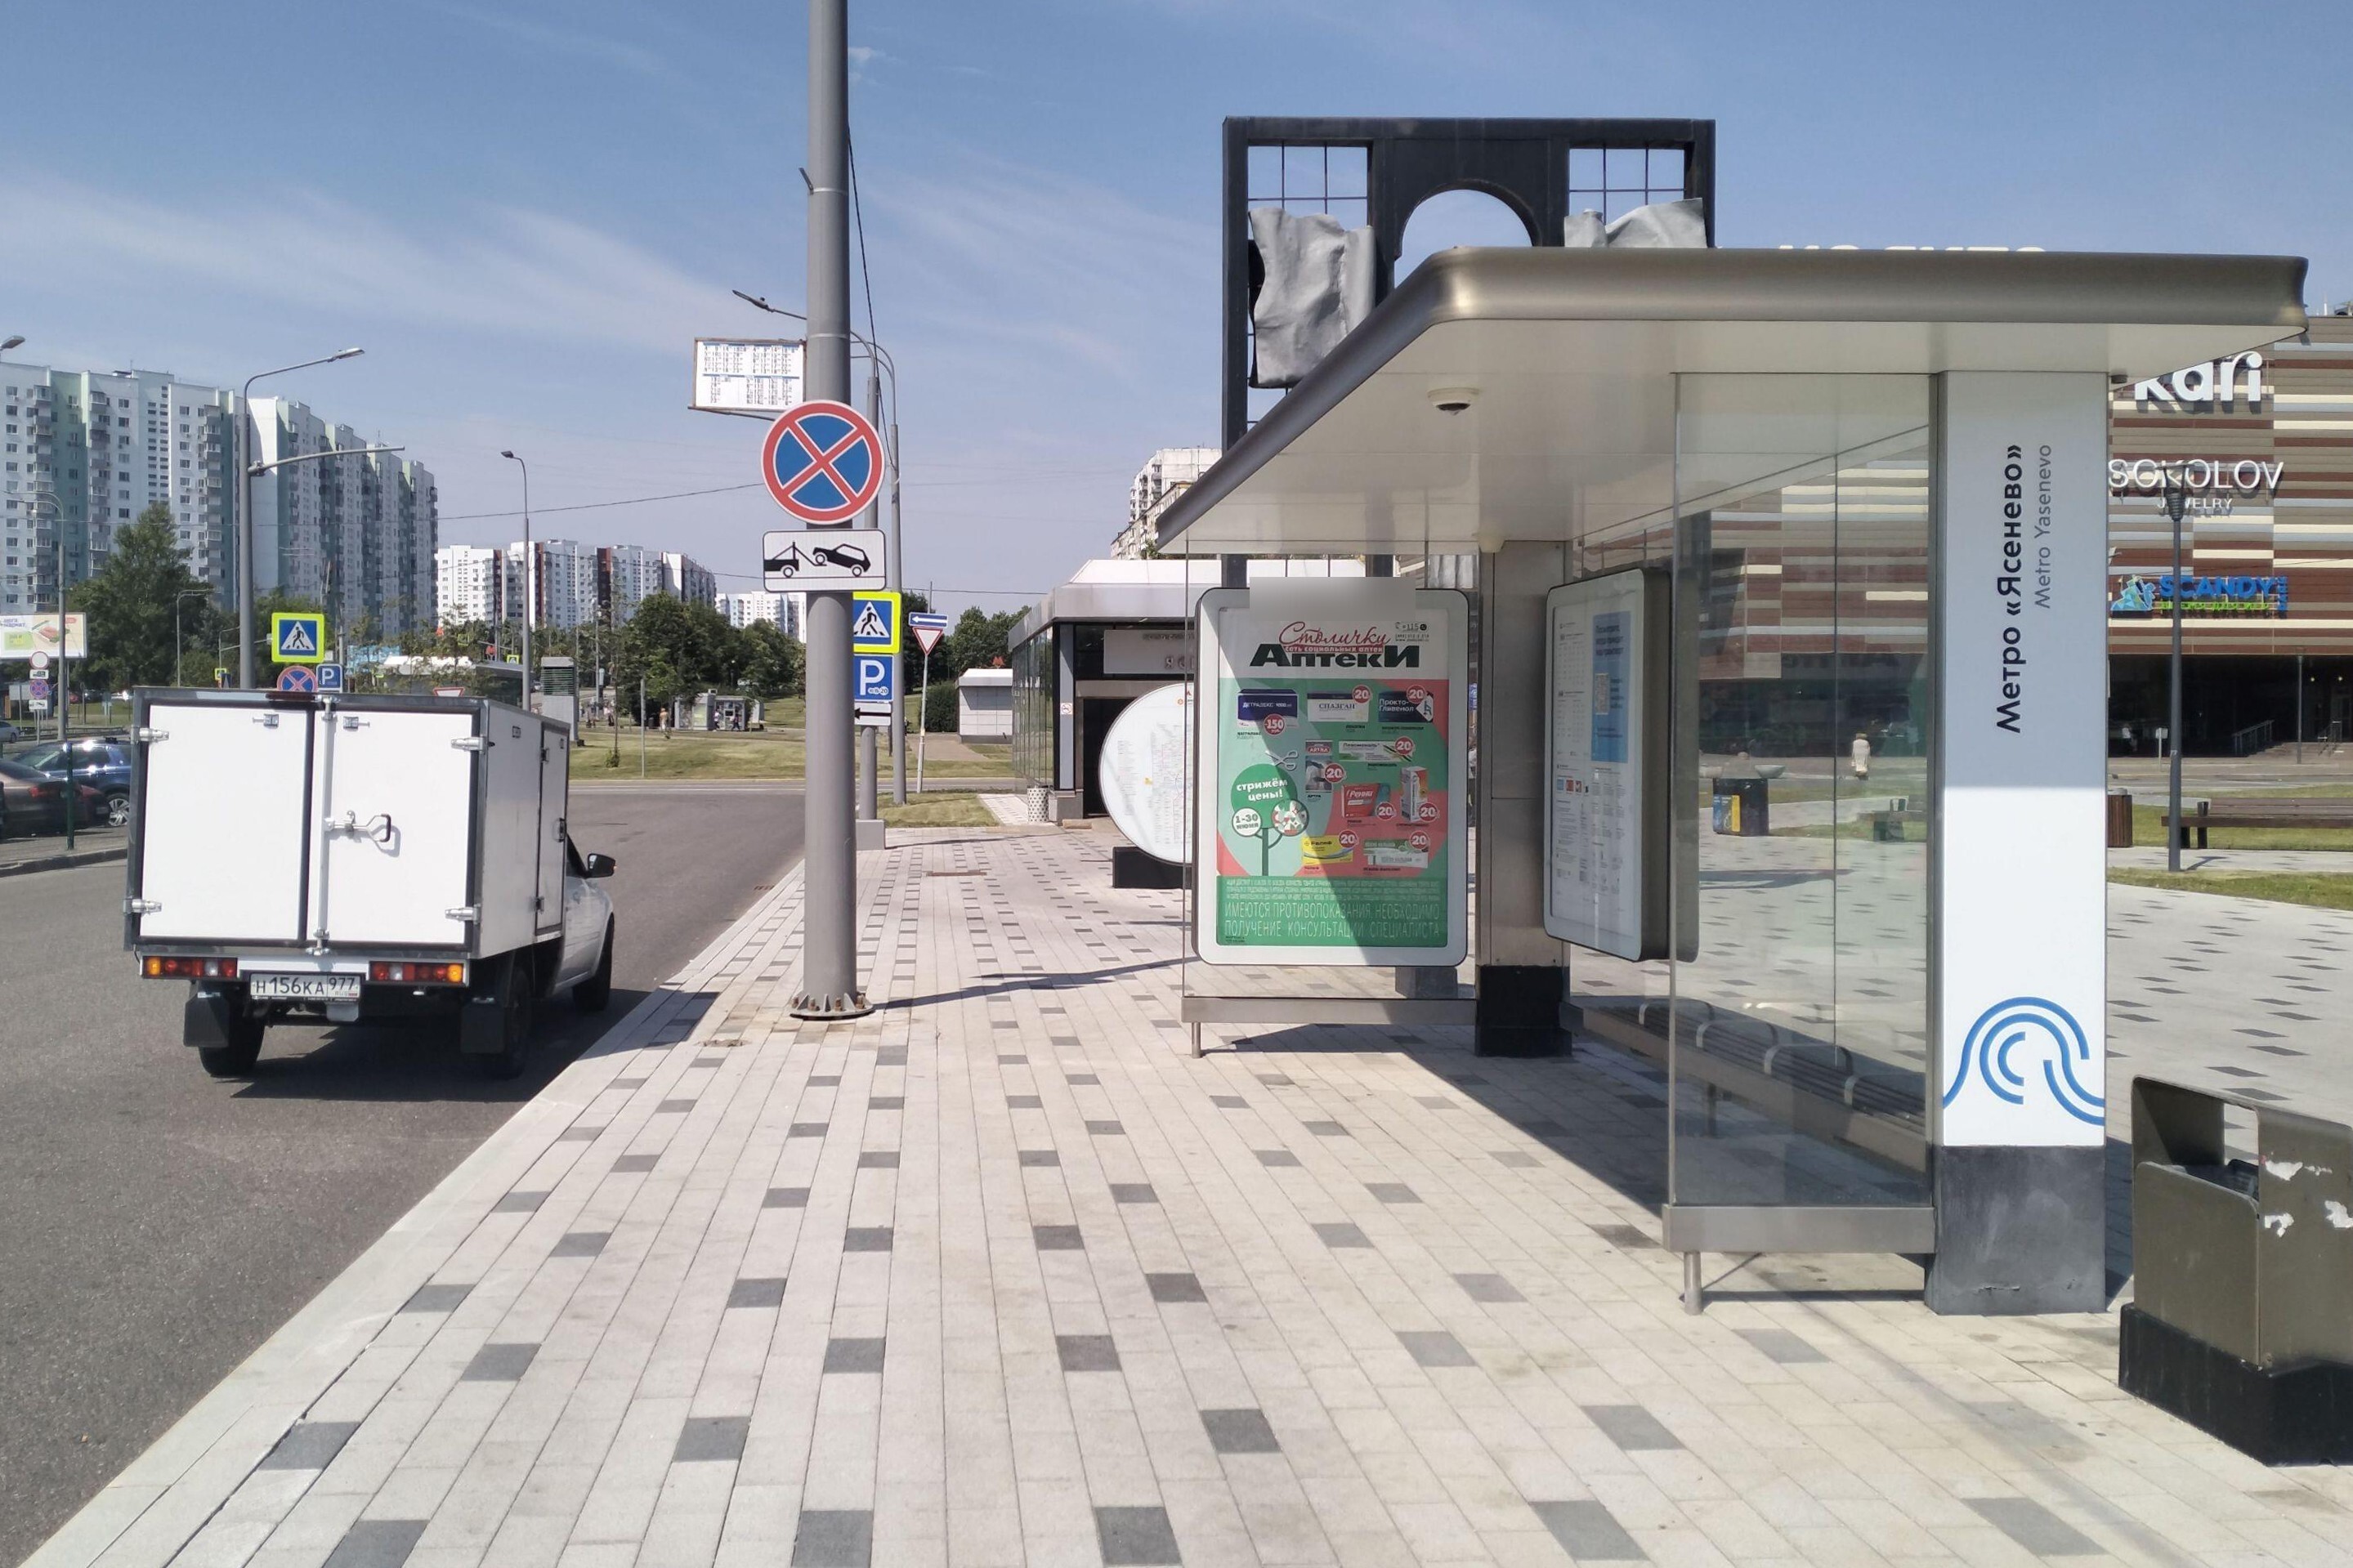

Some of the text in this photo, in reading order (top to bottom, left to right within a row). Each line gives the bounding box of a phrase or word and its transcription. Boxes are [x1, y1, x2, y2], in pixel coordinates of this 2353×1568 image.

[2107, 458, 2284, 489] SOKOLOV
[2156, 498, 2234, 509] JELRY
[2034, 444, 2051, 609] Metro Yasenevo
[1997, 444, 2026, 733] Метро «Ясенево»
[2159, 574, 2275, 598] SCANDY
[1278, 621, 1391, 645] Столички
[322, 668, 334, 685] P
[860, 659, 885, 695] P
[1237, 778, 1288, 792] стрижём
[1248, 788, 1283, 802] цены!
[1235, 814, 1259, 823] 1-30
[1225, 901, 1269, 918] ИМЕЮТСЯ
[1376, 903, 1439, 919] НЕОБХОДИМО
[1225, 920, 1440, 938] ПОЛУЧЕНИЕ КОНСУЛЬТАЦИИ СПЕЦИАЛИСТА
[329, 977, 356, 990] 977
